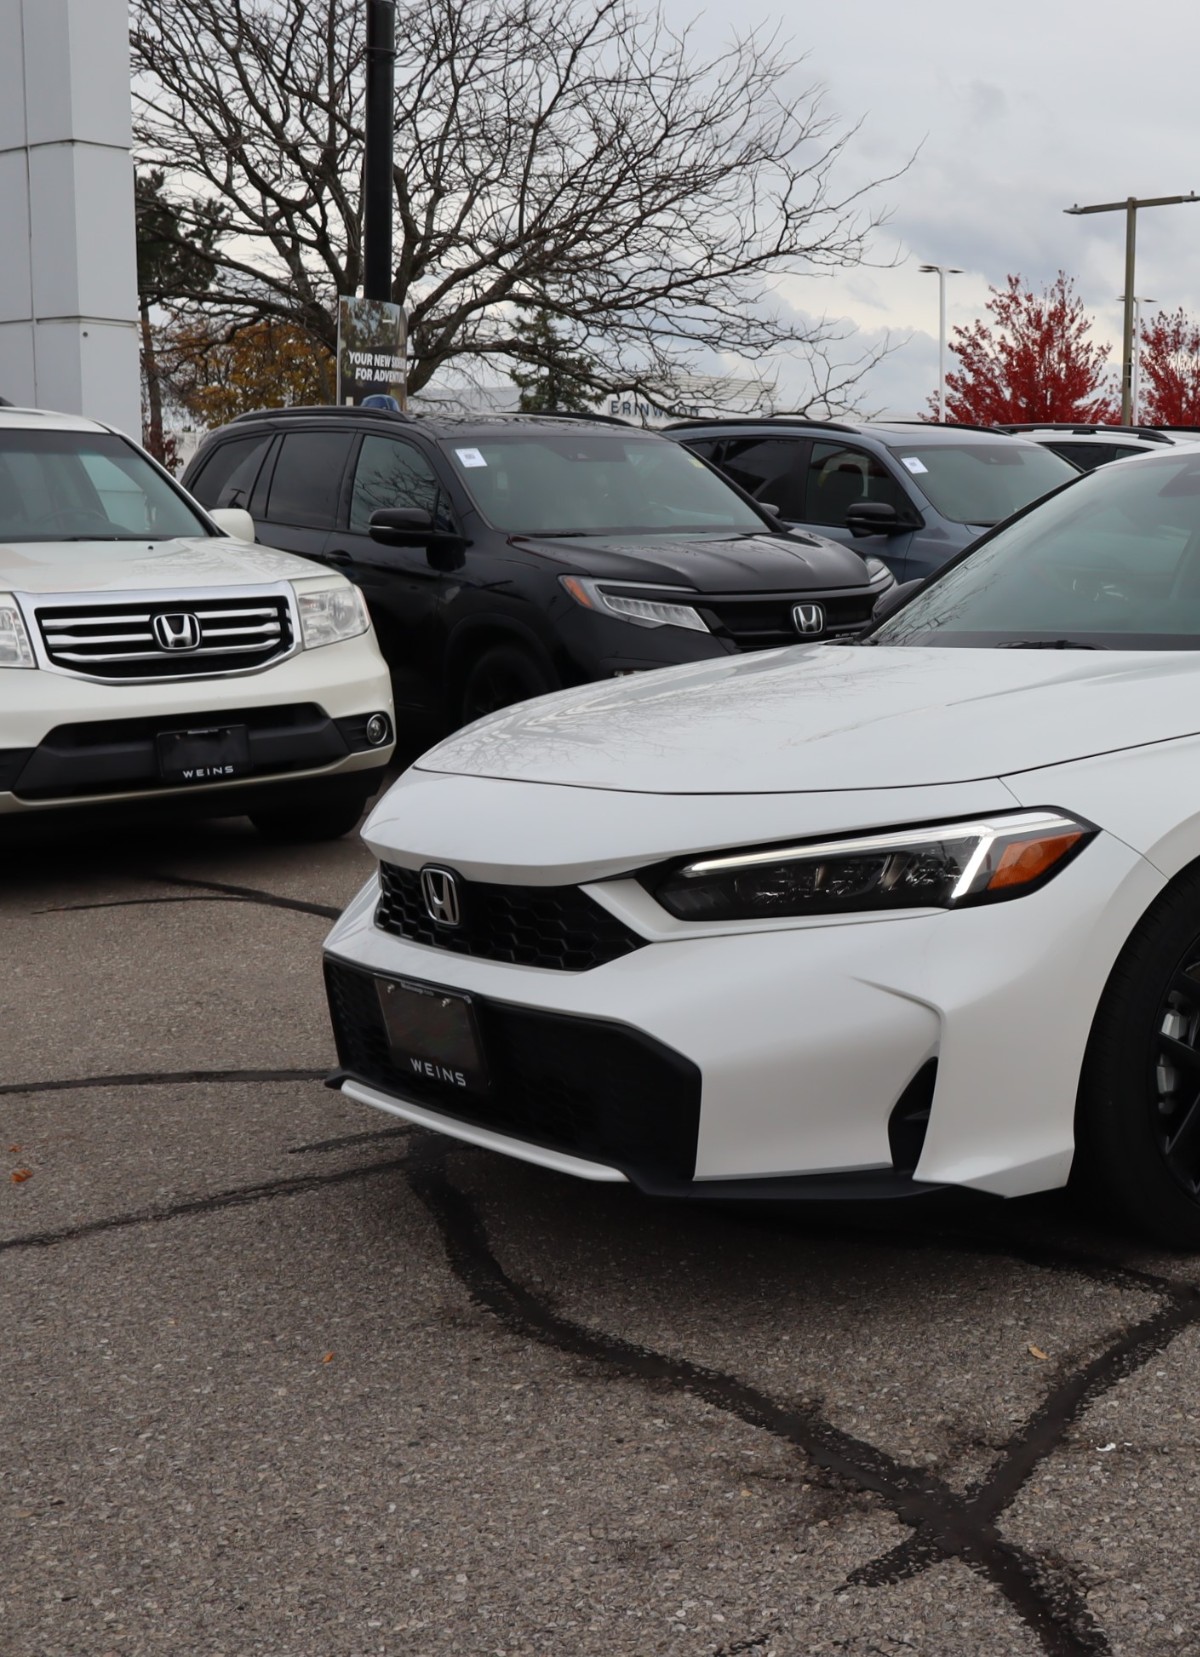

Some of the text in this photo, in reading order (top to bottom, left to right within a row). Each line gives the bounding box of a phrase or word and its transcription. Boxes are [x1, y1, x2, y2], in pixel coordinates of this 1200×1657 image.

[348, 350, 373, 365] YOUR
[373, 354, 391, 368] NEW
[355, 368, 373, 381] FOR
[182, 765, 234, 779] WEINS
[410, 1057, 467, 1087] WEINS
